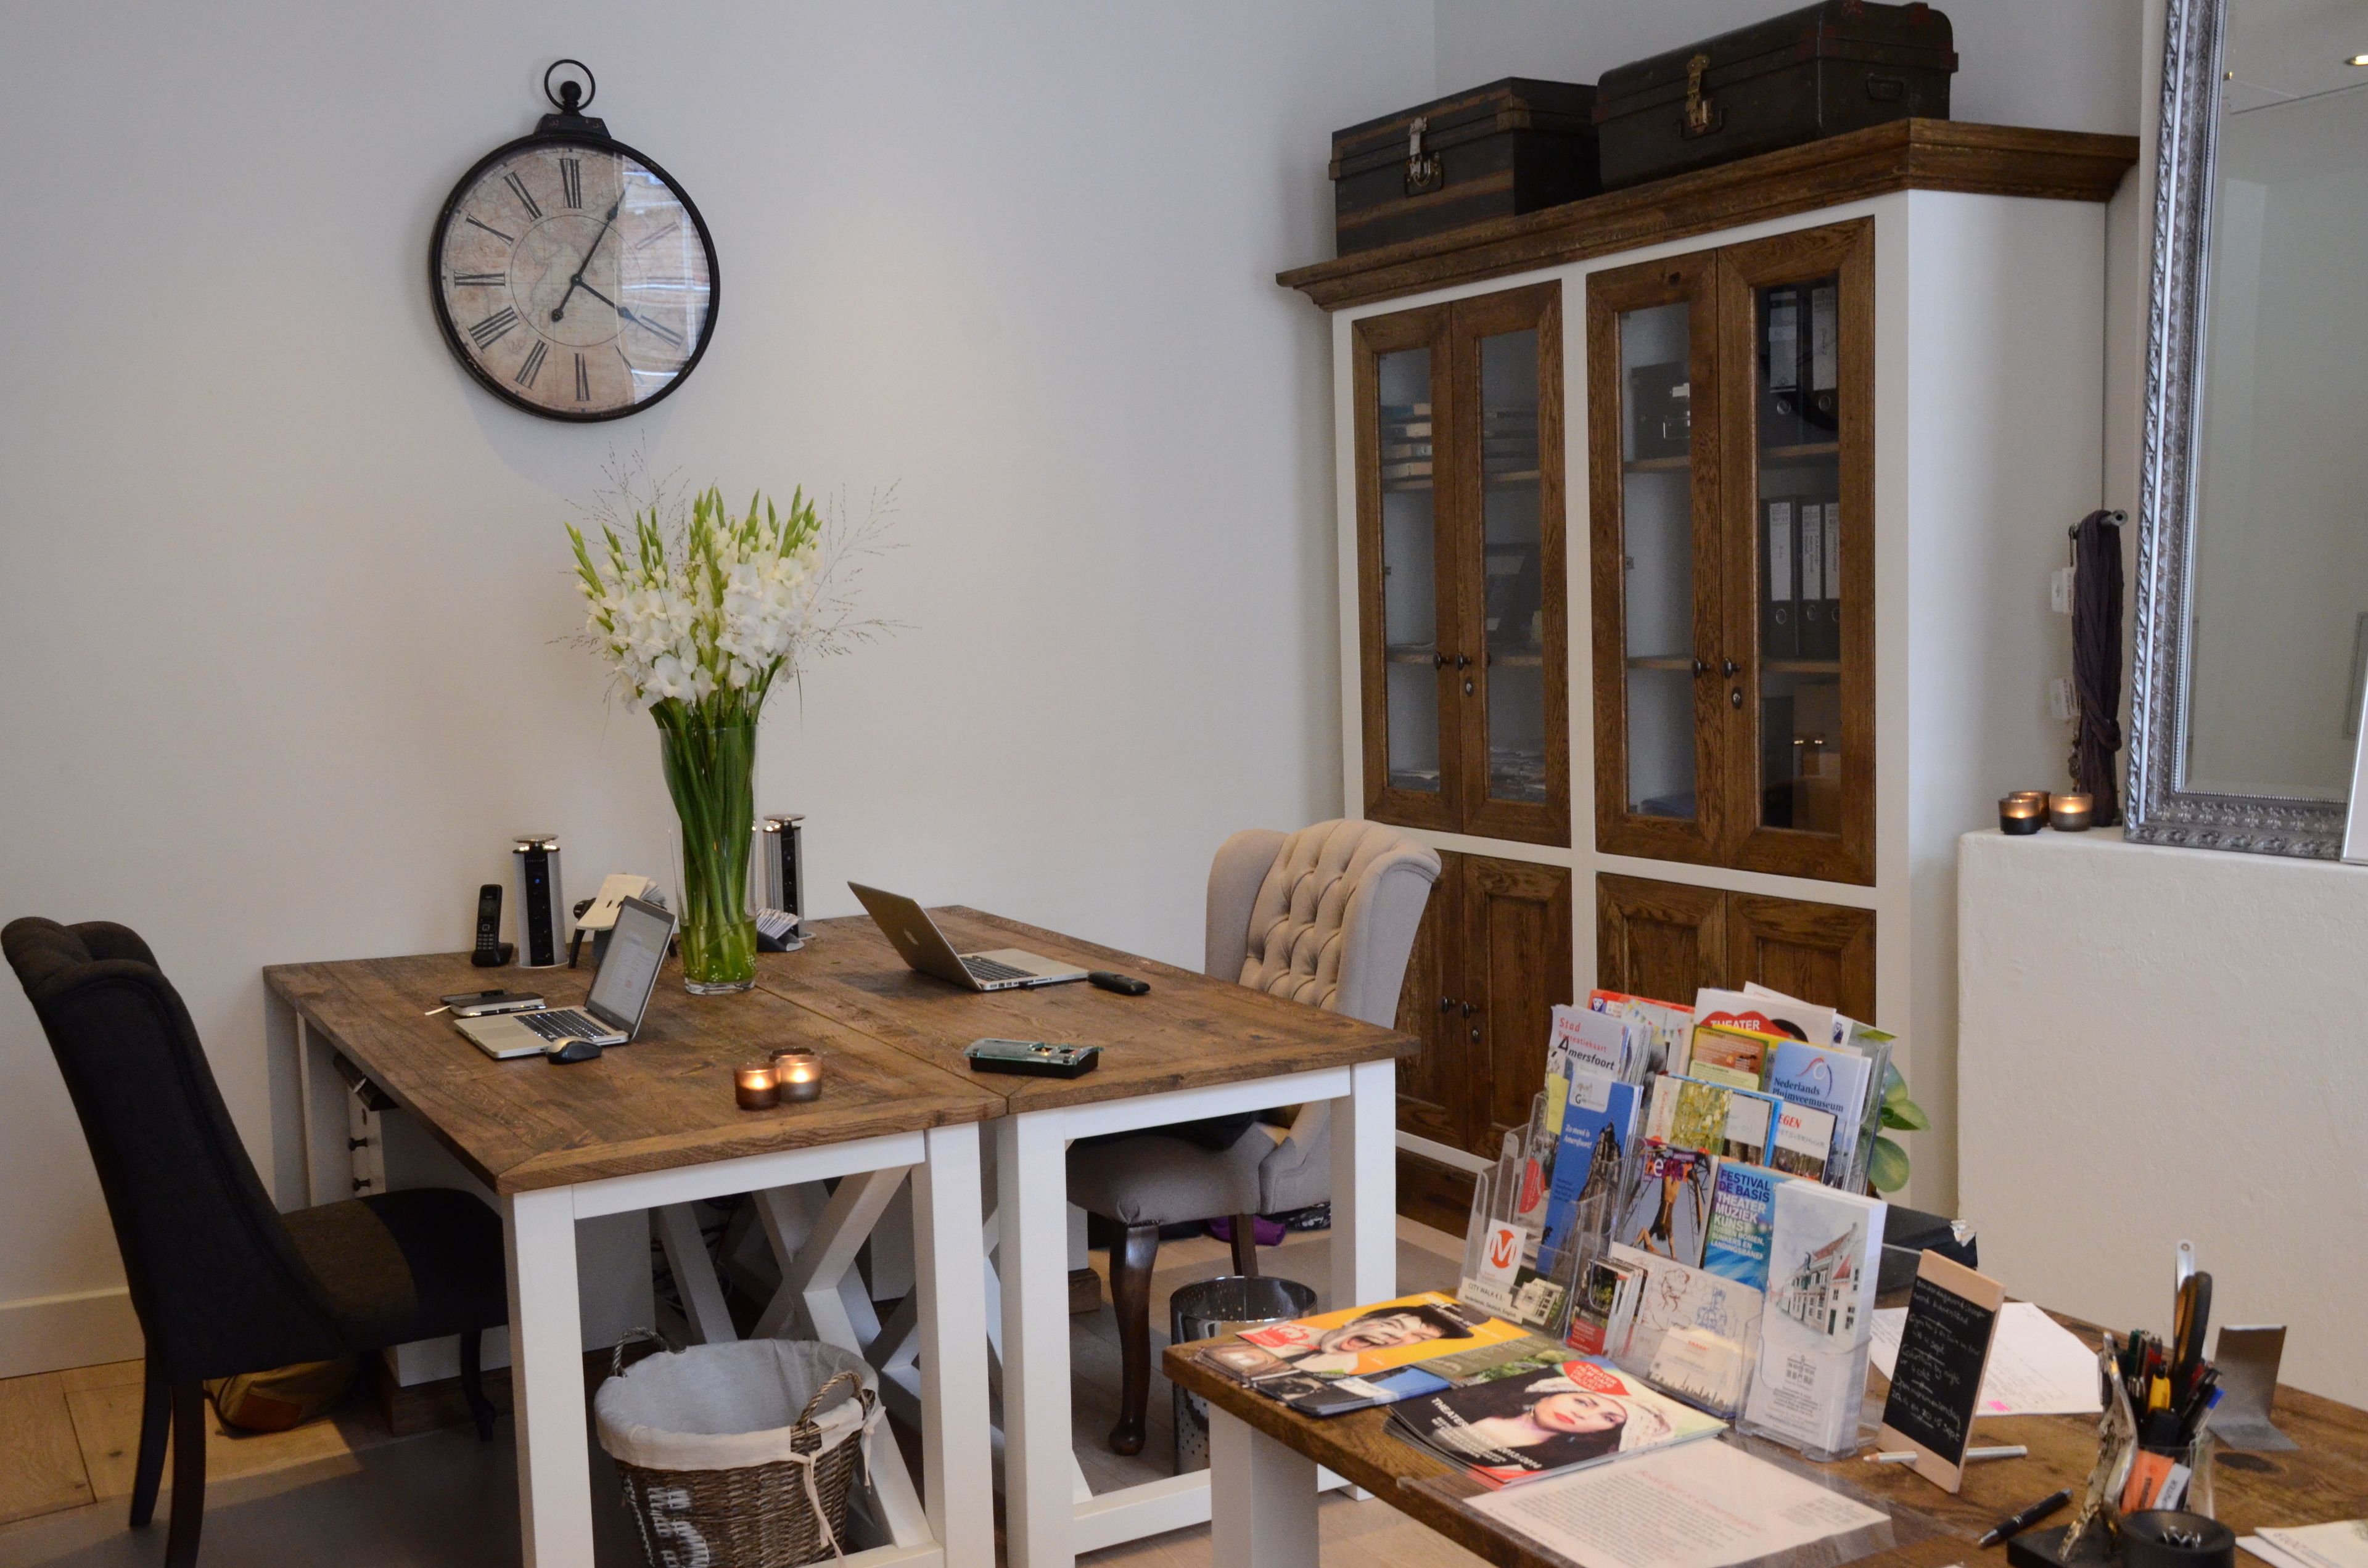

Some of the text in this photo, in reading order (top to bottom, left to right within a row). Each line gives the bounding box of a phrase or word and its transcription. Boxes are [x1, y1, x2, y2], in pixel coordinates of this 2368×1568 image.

[1558, 1017, 1581, 1033] Stad
[1711, 1020, 1760, 1030] THEATER
[1551, 1036, 1615, 1071] Amersfoort
[1774, 1077, 1820, 1096] Nederlands
[1772, 1088, 1844, 1112] Pluimveemuseum
[1720, 1170, 1770, 1191] FESTIVAL
[1718, 1181, 1770, 1202] DE BASIS
[1717, 1191, 1766, 1214] THEATER
[1715, 1204, 1758, 1224] MUZIEK
[1714, 1215, 1753, 1233] KUNST
[1742, 1240, 1753, 1249] EN
[1468, 1282, 1479, 1292] CITY
[1480, 1286, 1494, 1298] WALK
